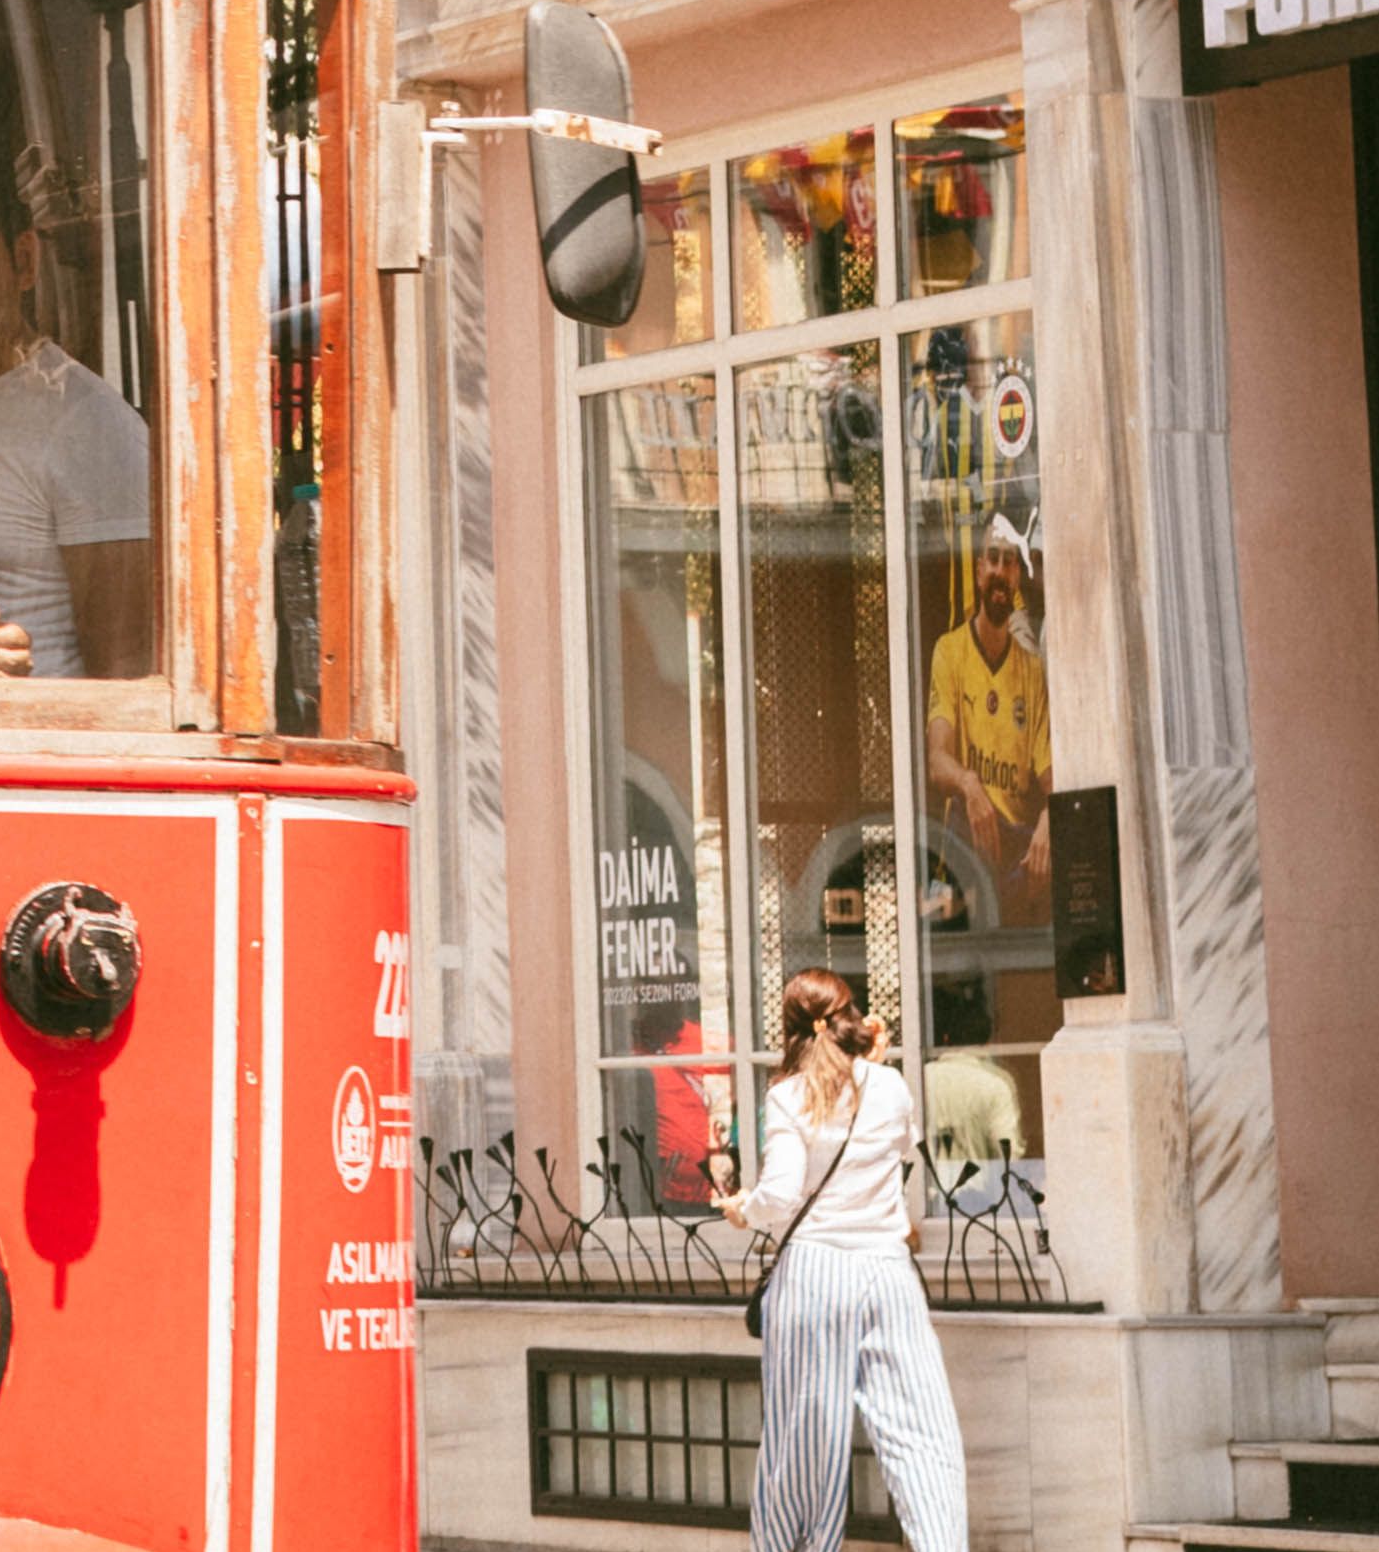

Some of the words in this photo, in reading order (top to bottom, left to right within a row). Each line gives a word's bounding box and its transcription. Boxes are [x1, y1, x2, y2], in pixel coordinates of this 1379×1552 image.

[599, 836, 679, 909] DAİMA
[601, 917, 686, 979] FENER.
[320, 1308, 352, 1351] VE
